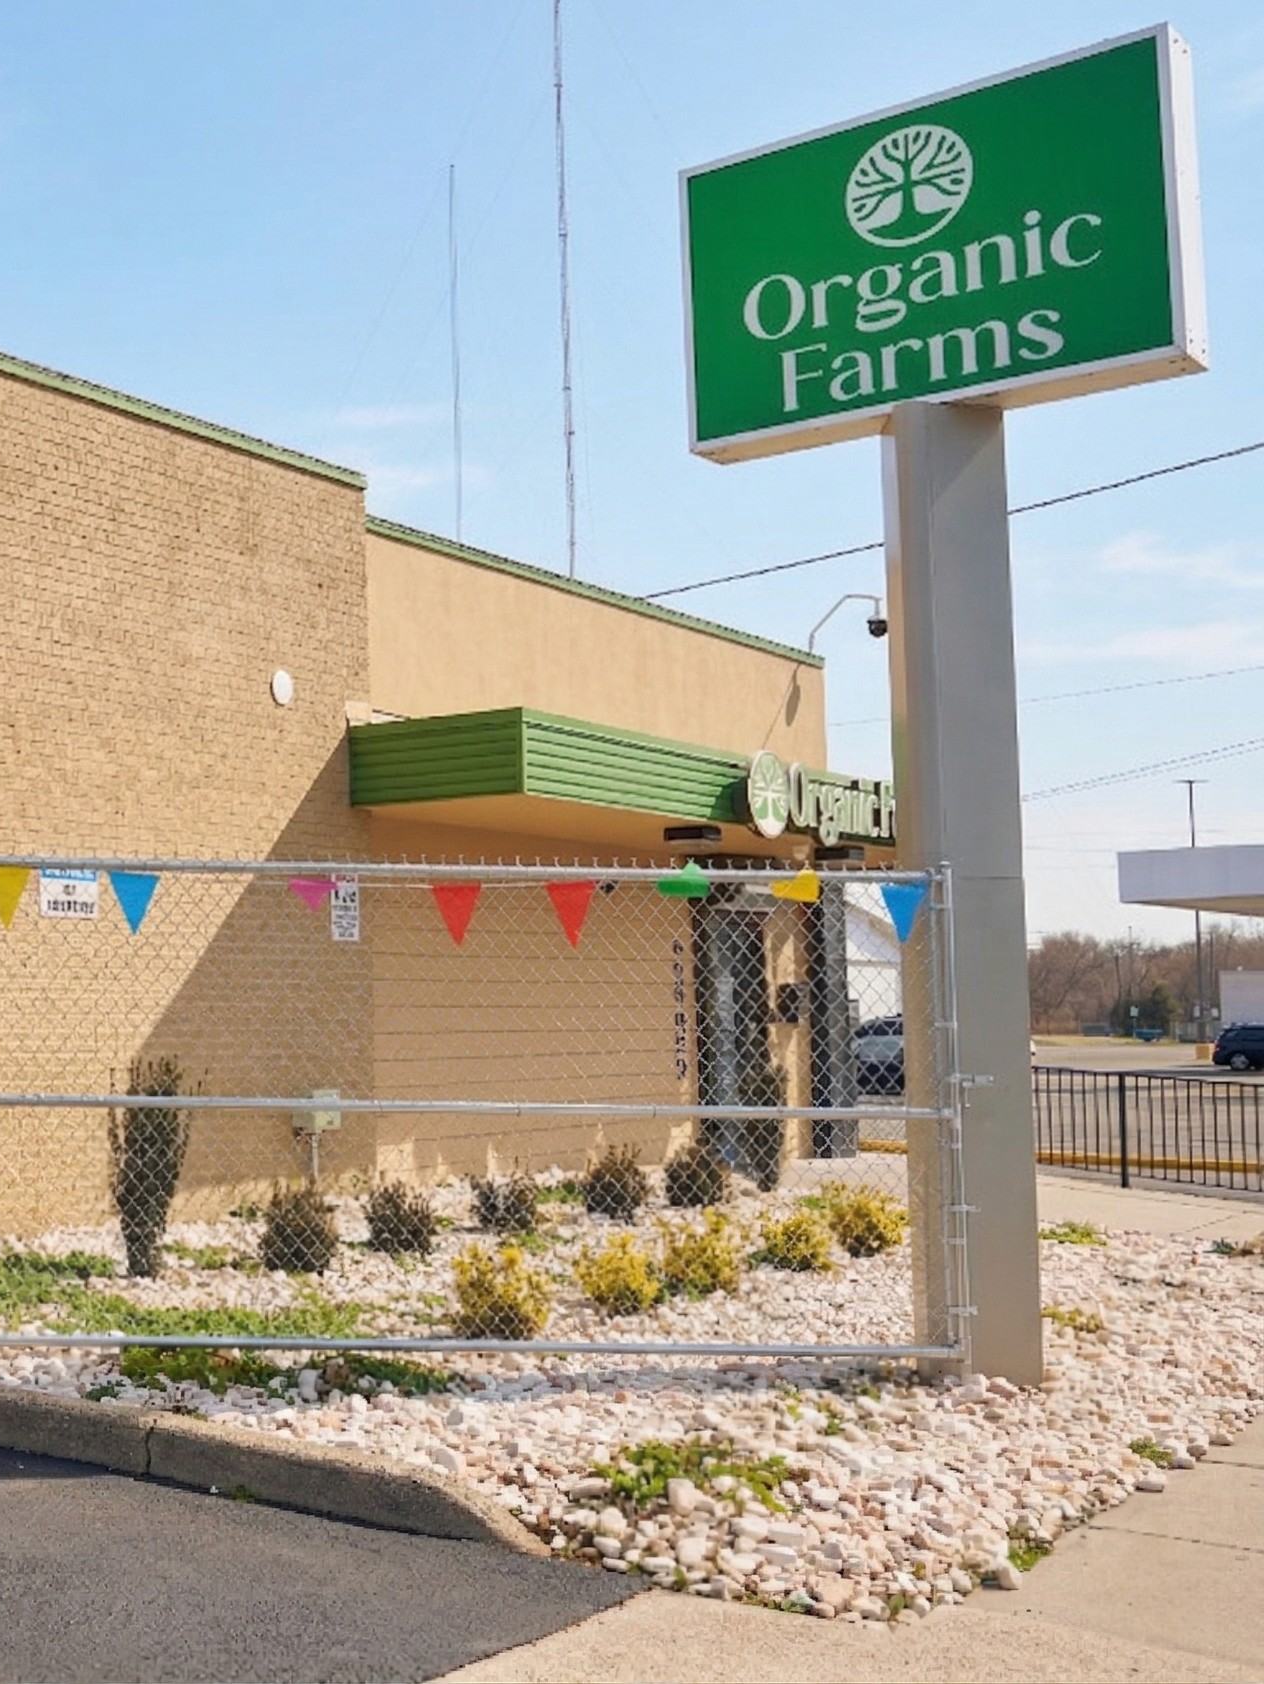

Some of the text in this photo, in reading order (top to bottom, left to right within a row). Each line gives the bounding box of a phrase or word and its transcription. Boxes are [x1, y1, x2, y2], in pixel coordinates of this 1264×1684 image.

[742, 209, 1103, 341] Organic
[779, 308, 1064, 412] Farms
[789, 762, 879, 847] Organic
